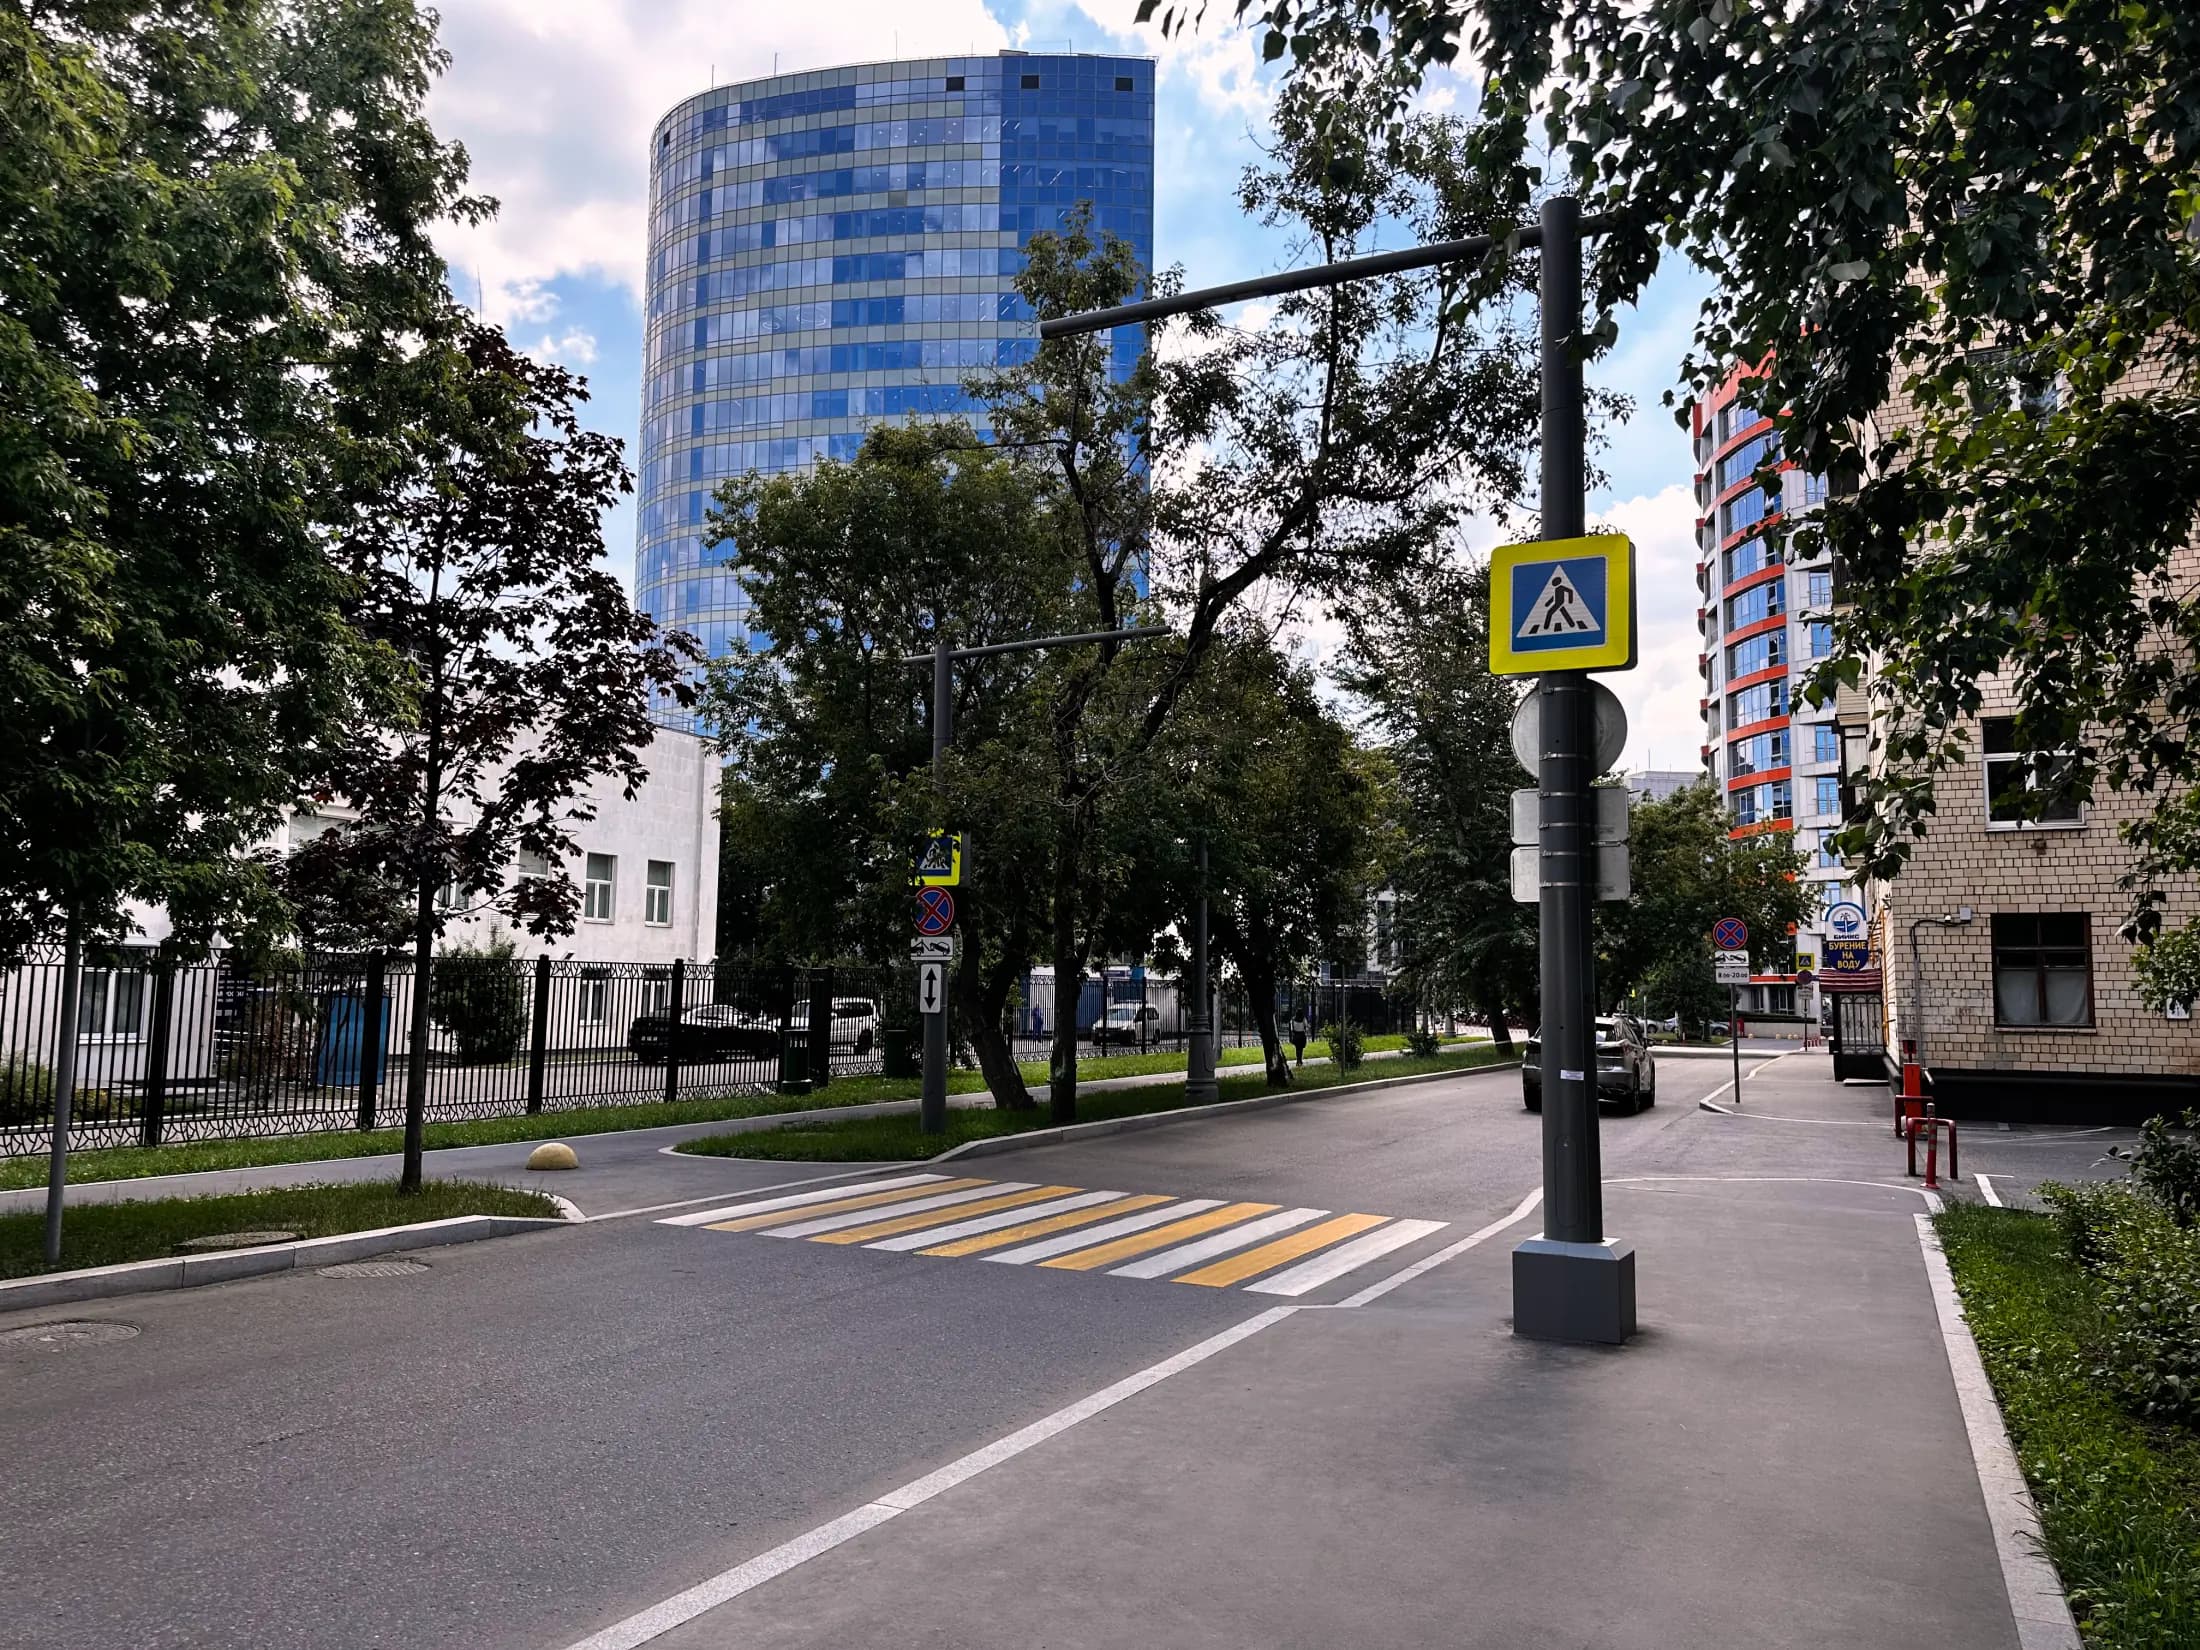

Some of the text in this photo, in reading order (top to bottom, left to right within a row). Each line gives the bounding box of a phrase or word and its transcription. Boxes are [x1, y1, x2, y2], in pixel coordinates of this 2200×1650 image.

[1828, 942, 1866, 950] БУРЕНИЕ
[1842, 951, 1854, 959] НА
[1837, 960, 1860, 969] ВОДУ
